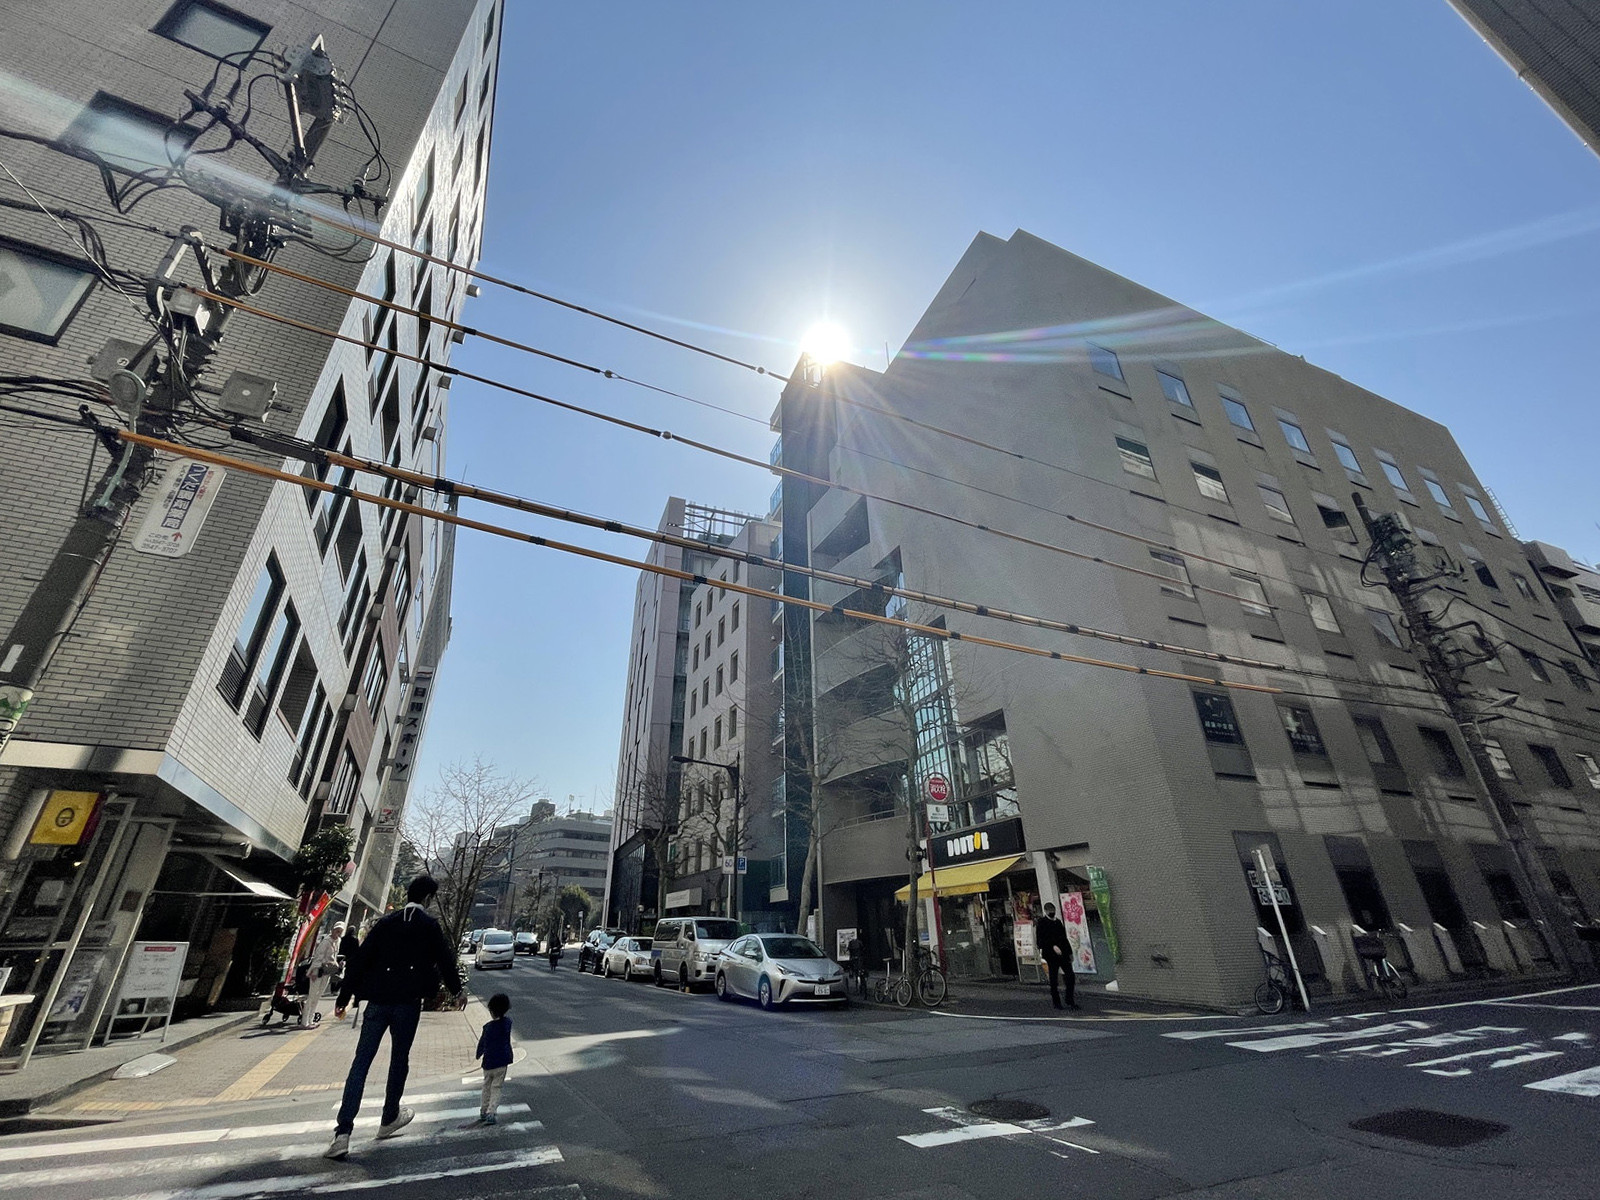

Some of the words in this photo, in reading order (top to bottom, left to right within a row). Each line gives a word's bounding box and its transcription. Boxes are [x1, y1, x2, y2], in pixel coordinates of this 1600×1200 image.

[395, 686, 427, 774] 日刊スポーツ
[946, 831, 989, 856] DOUTOR
